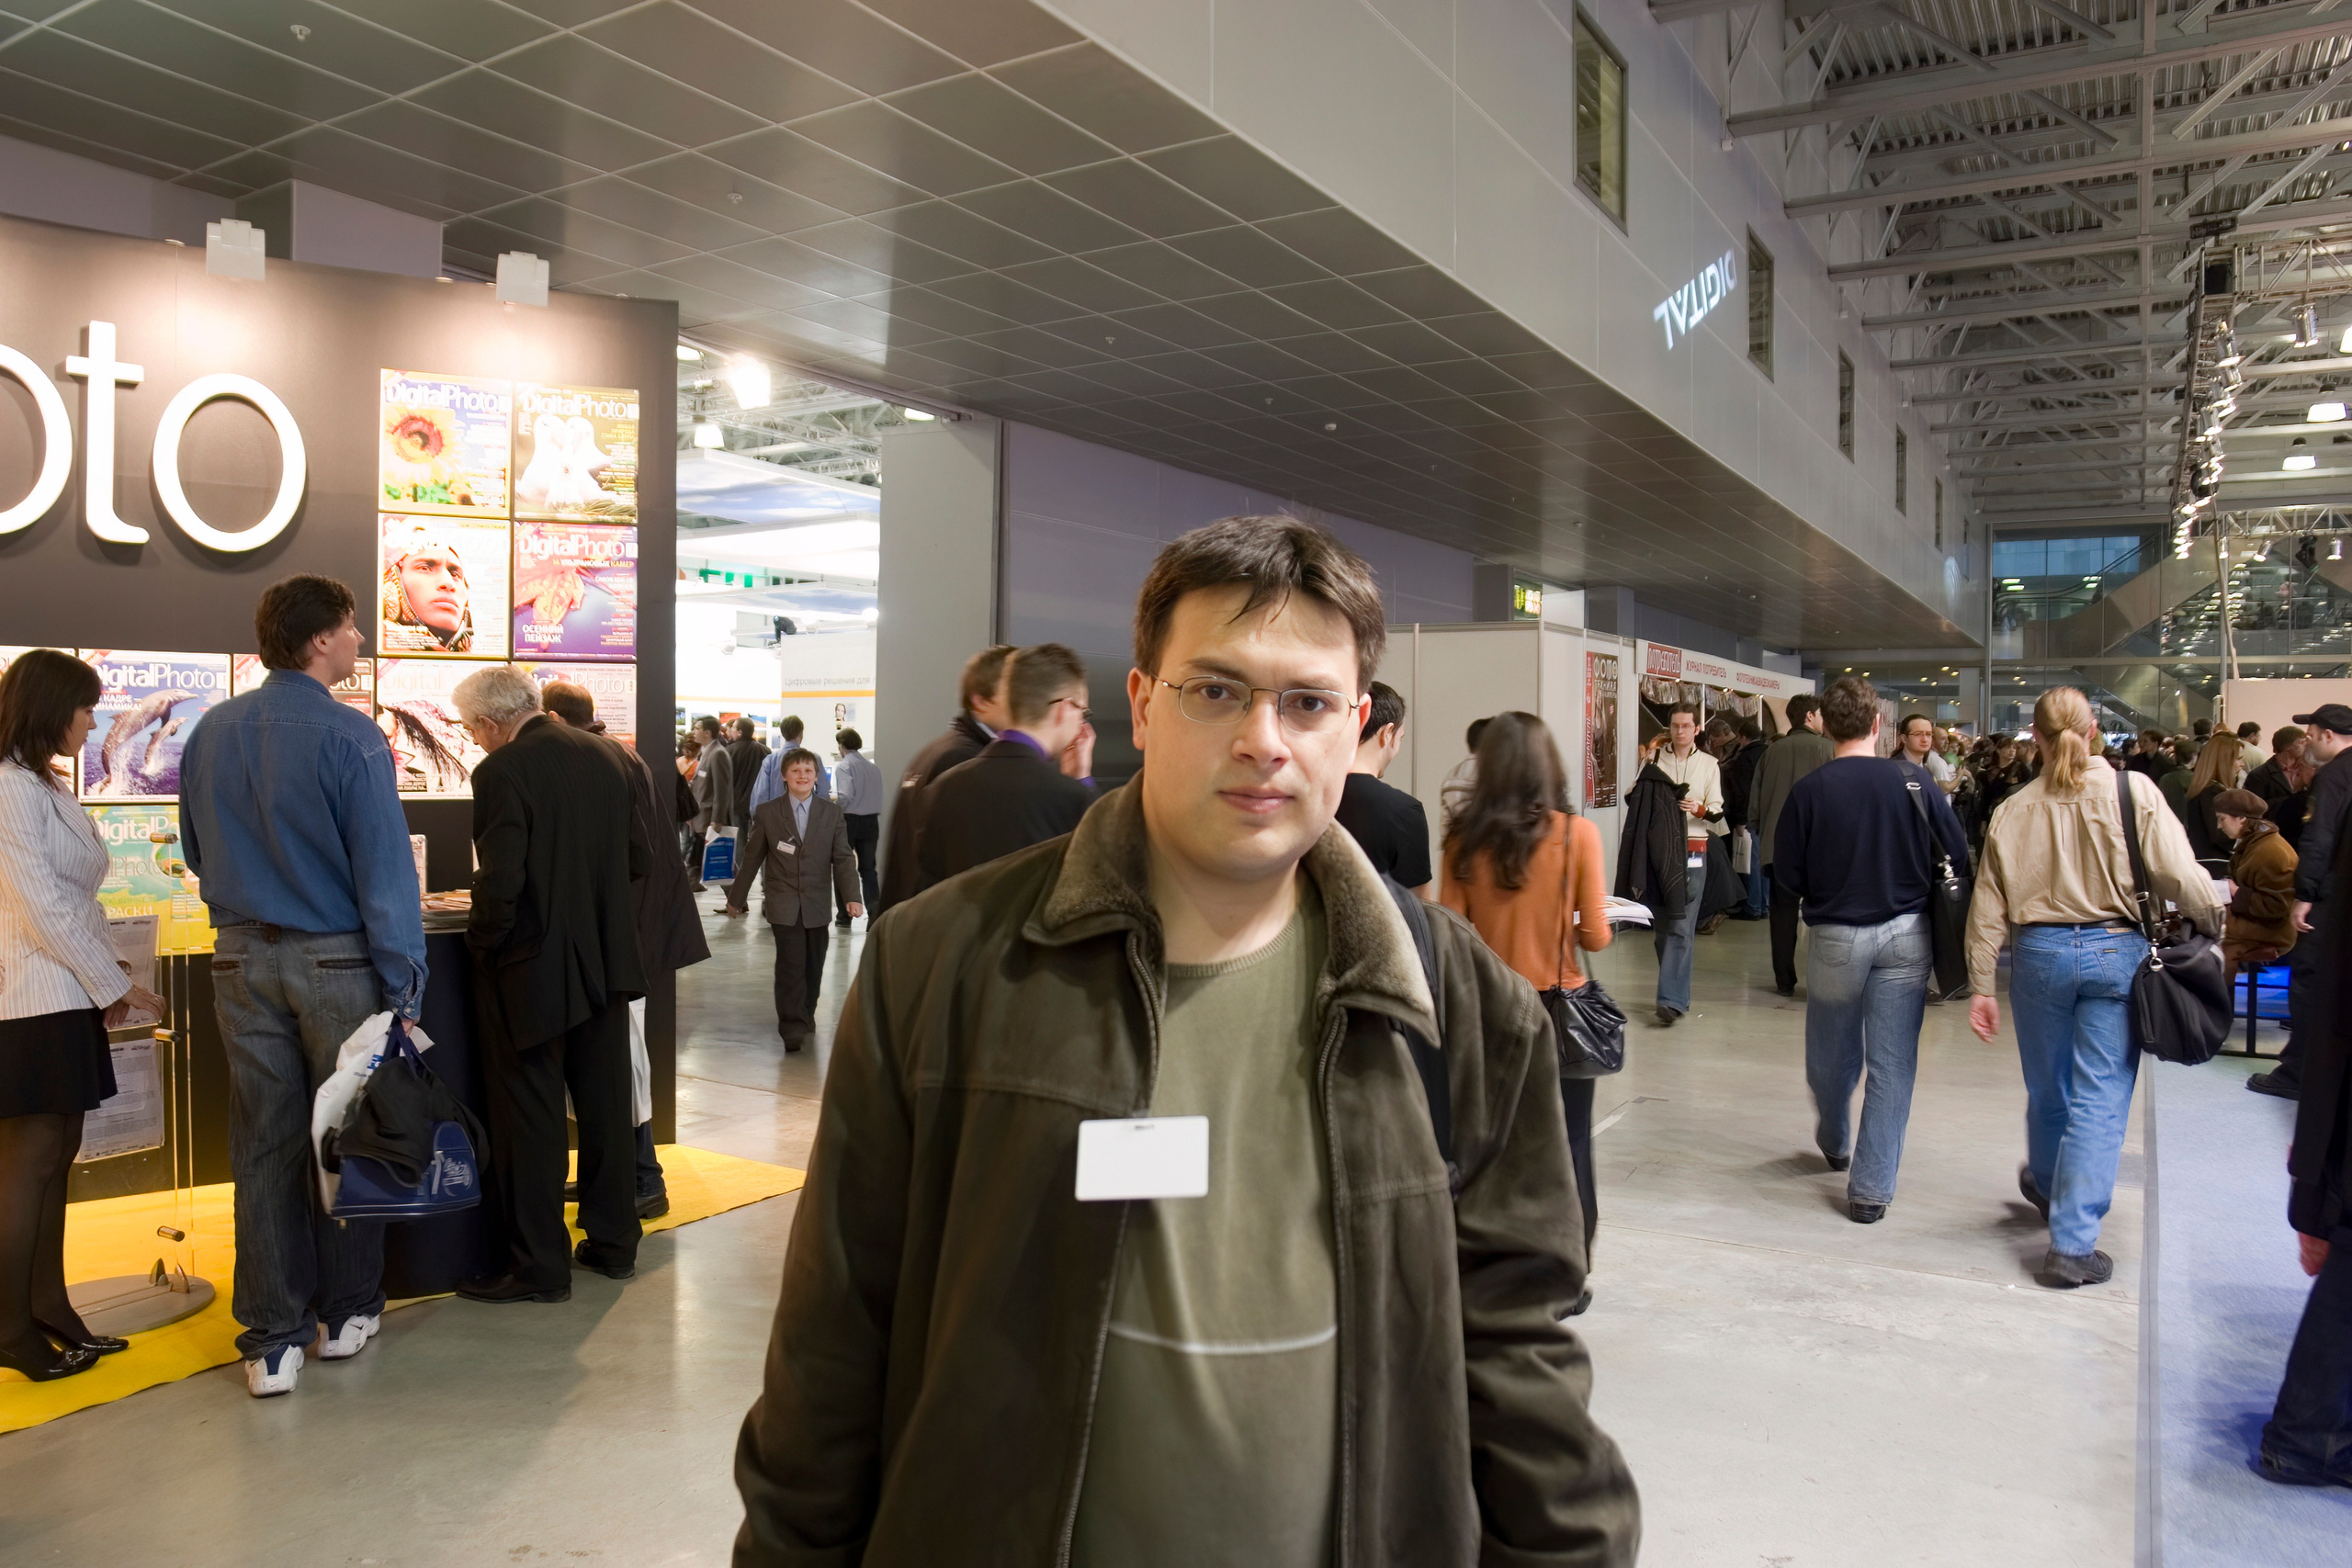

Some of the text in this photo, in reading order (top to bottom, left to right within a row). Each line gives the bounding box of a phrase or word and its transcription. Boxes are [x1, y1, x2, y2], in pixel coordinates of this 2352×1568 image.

[386, 381, 499, 412] DigitalPhoto
[523, 393, 628, 419] DigitalPhoto
[518, 534, 625, 560] DigitalPhoto
[522, 623, 564, 634] ОСЕННИЙ
[524, 632, 562, 643] ПЕЙЗАЖ
[785, 676, 870, 687] Цифровые решения для
[103, 694, 132, 703] КАДРЕ
